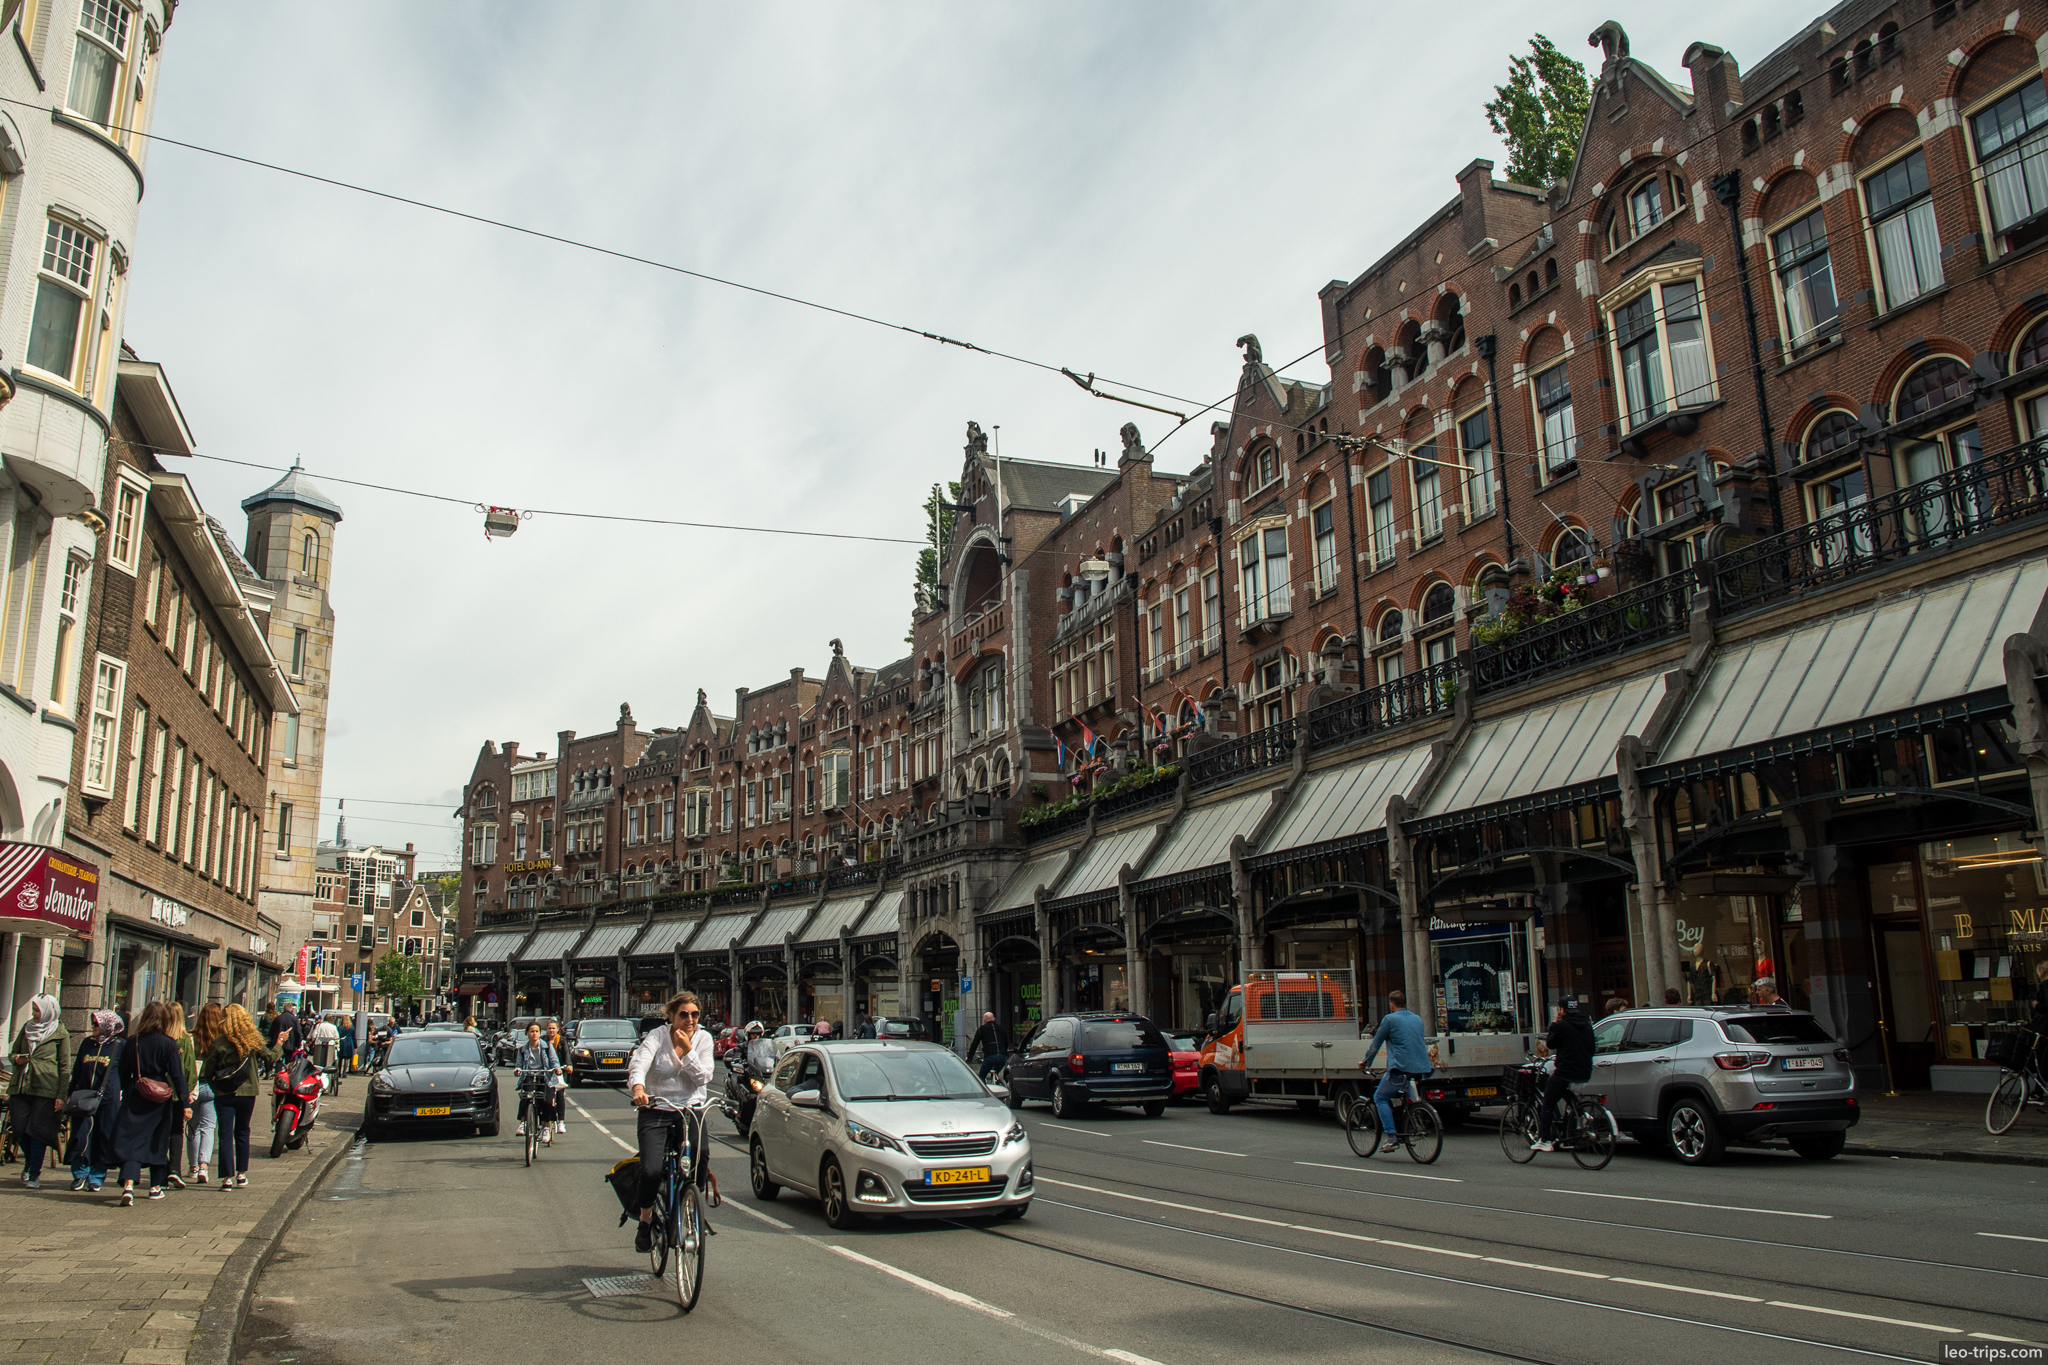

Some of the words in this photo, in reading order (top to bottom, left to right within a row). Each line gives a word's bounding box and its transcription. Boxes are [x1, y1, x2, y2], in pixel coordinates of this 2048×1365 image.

[504, 862, 525, 872] HOTEL
[45, 877, 93, 921] Jennifer
[1676, 919, 1704, 950] Bey
[2008, 943, 2042, 953] PARIS
[1466, 960, 1481, 968] Lunch
[964, 981, 970, 989] P
[1021, 984, 1042, 999] OUTLE
[1481, 1000, 1501, 1010] House
[1027, 1006, 1041, 1020] 70%
[935, 1170, 984, 1183] KD-241-L
